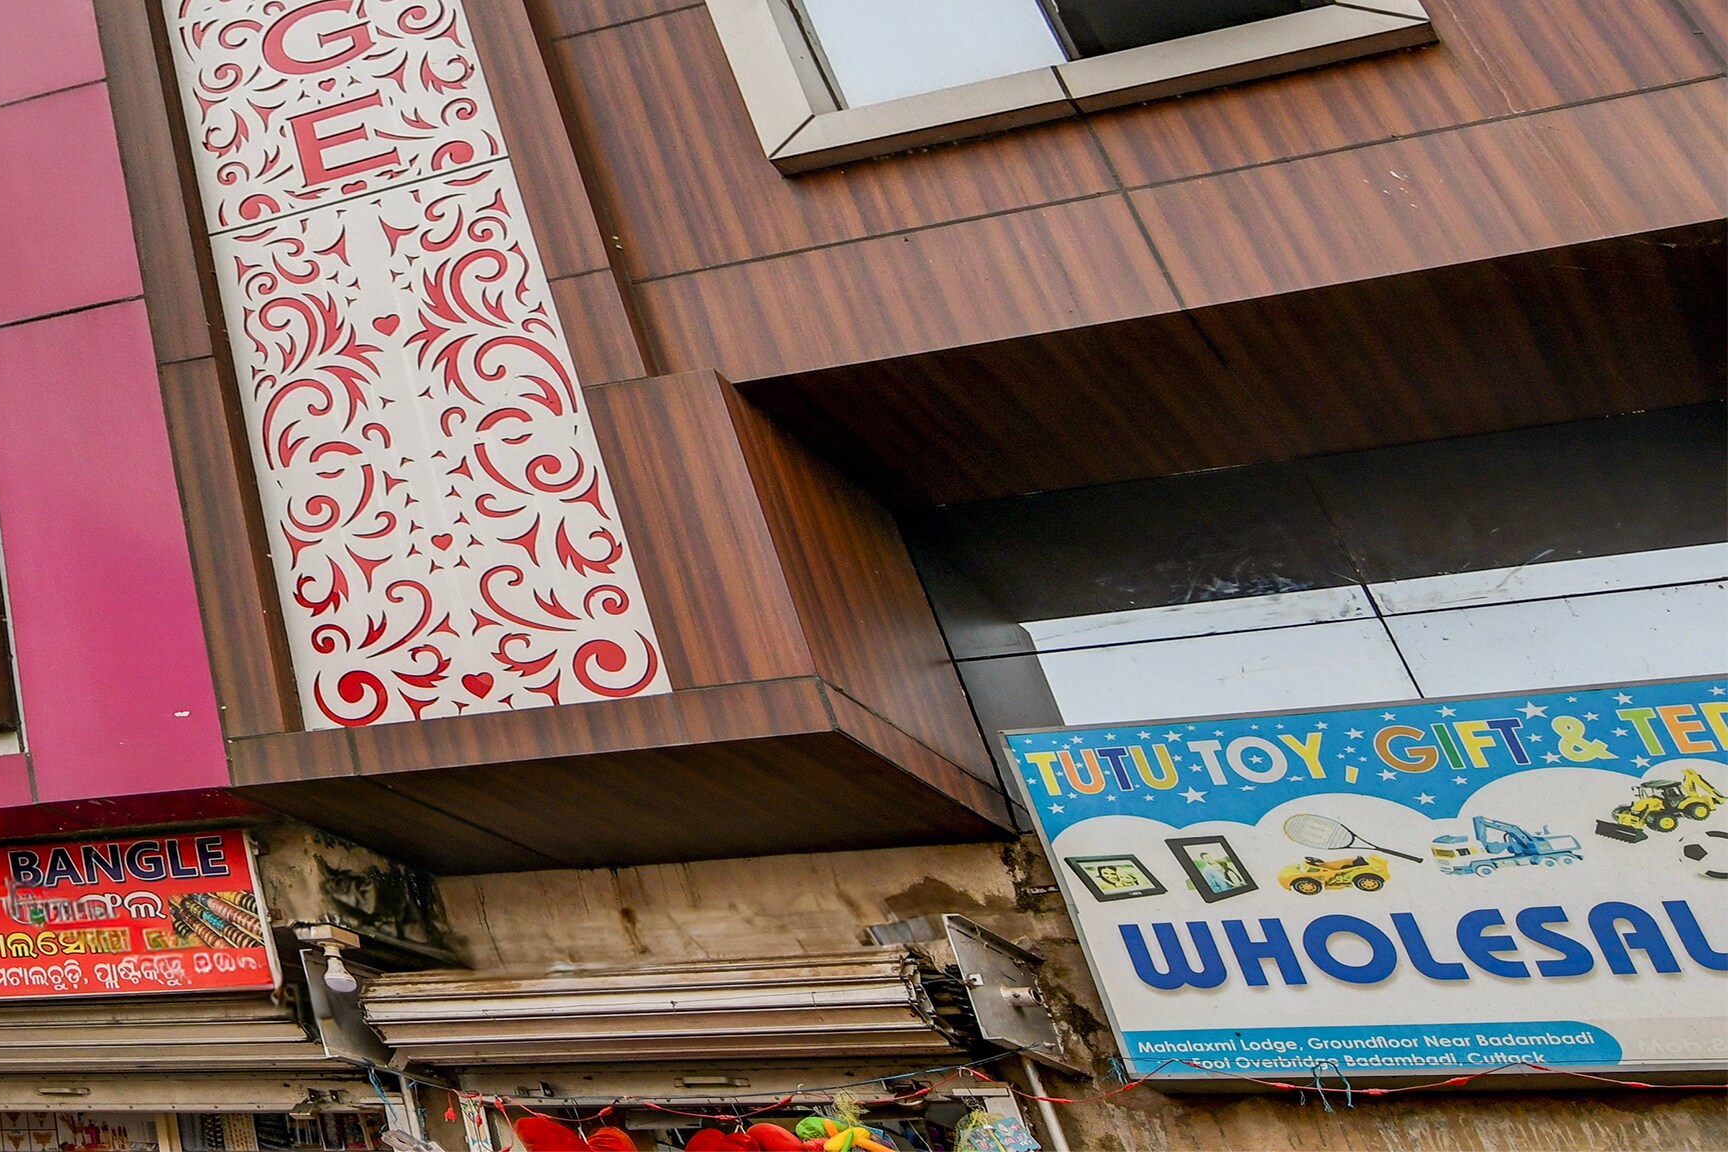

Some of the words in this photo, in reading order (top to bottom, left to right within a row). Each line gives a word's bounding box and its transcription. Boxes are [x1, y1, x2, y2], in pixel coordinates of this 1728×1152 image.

[1026, 743, 1178, 798] TUTU
[1373, 717, 1532, 774] GIFT
[1547, 714, 1620, 762] &
[7, 835, 230, 889] BANGLE
[1138, 1036, 1237, 1055] Mahalaxmi
[1307, 1032, 1420, 1052] Groundfloor
[1424, 1032, 1472, 1049] Near
[1475, 1029, 1595, 1048] Badambadi
[1193, 1053, 1240, 1069] Foot
[1243, 1052, 1339, 1069] Overbridge
[1466, 1048, 1546, 1065] Cuttack
